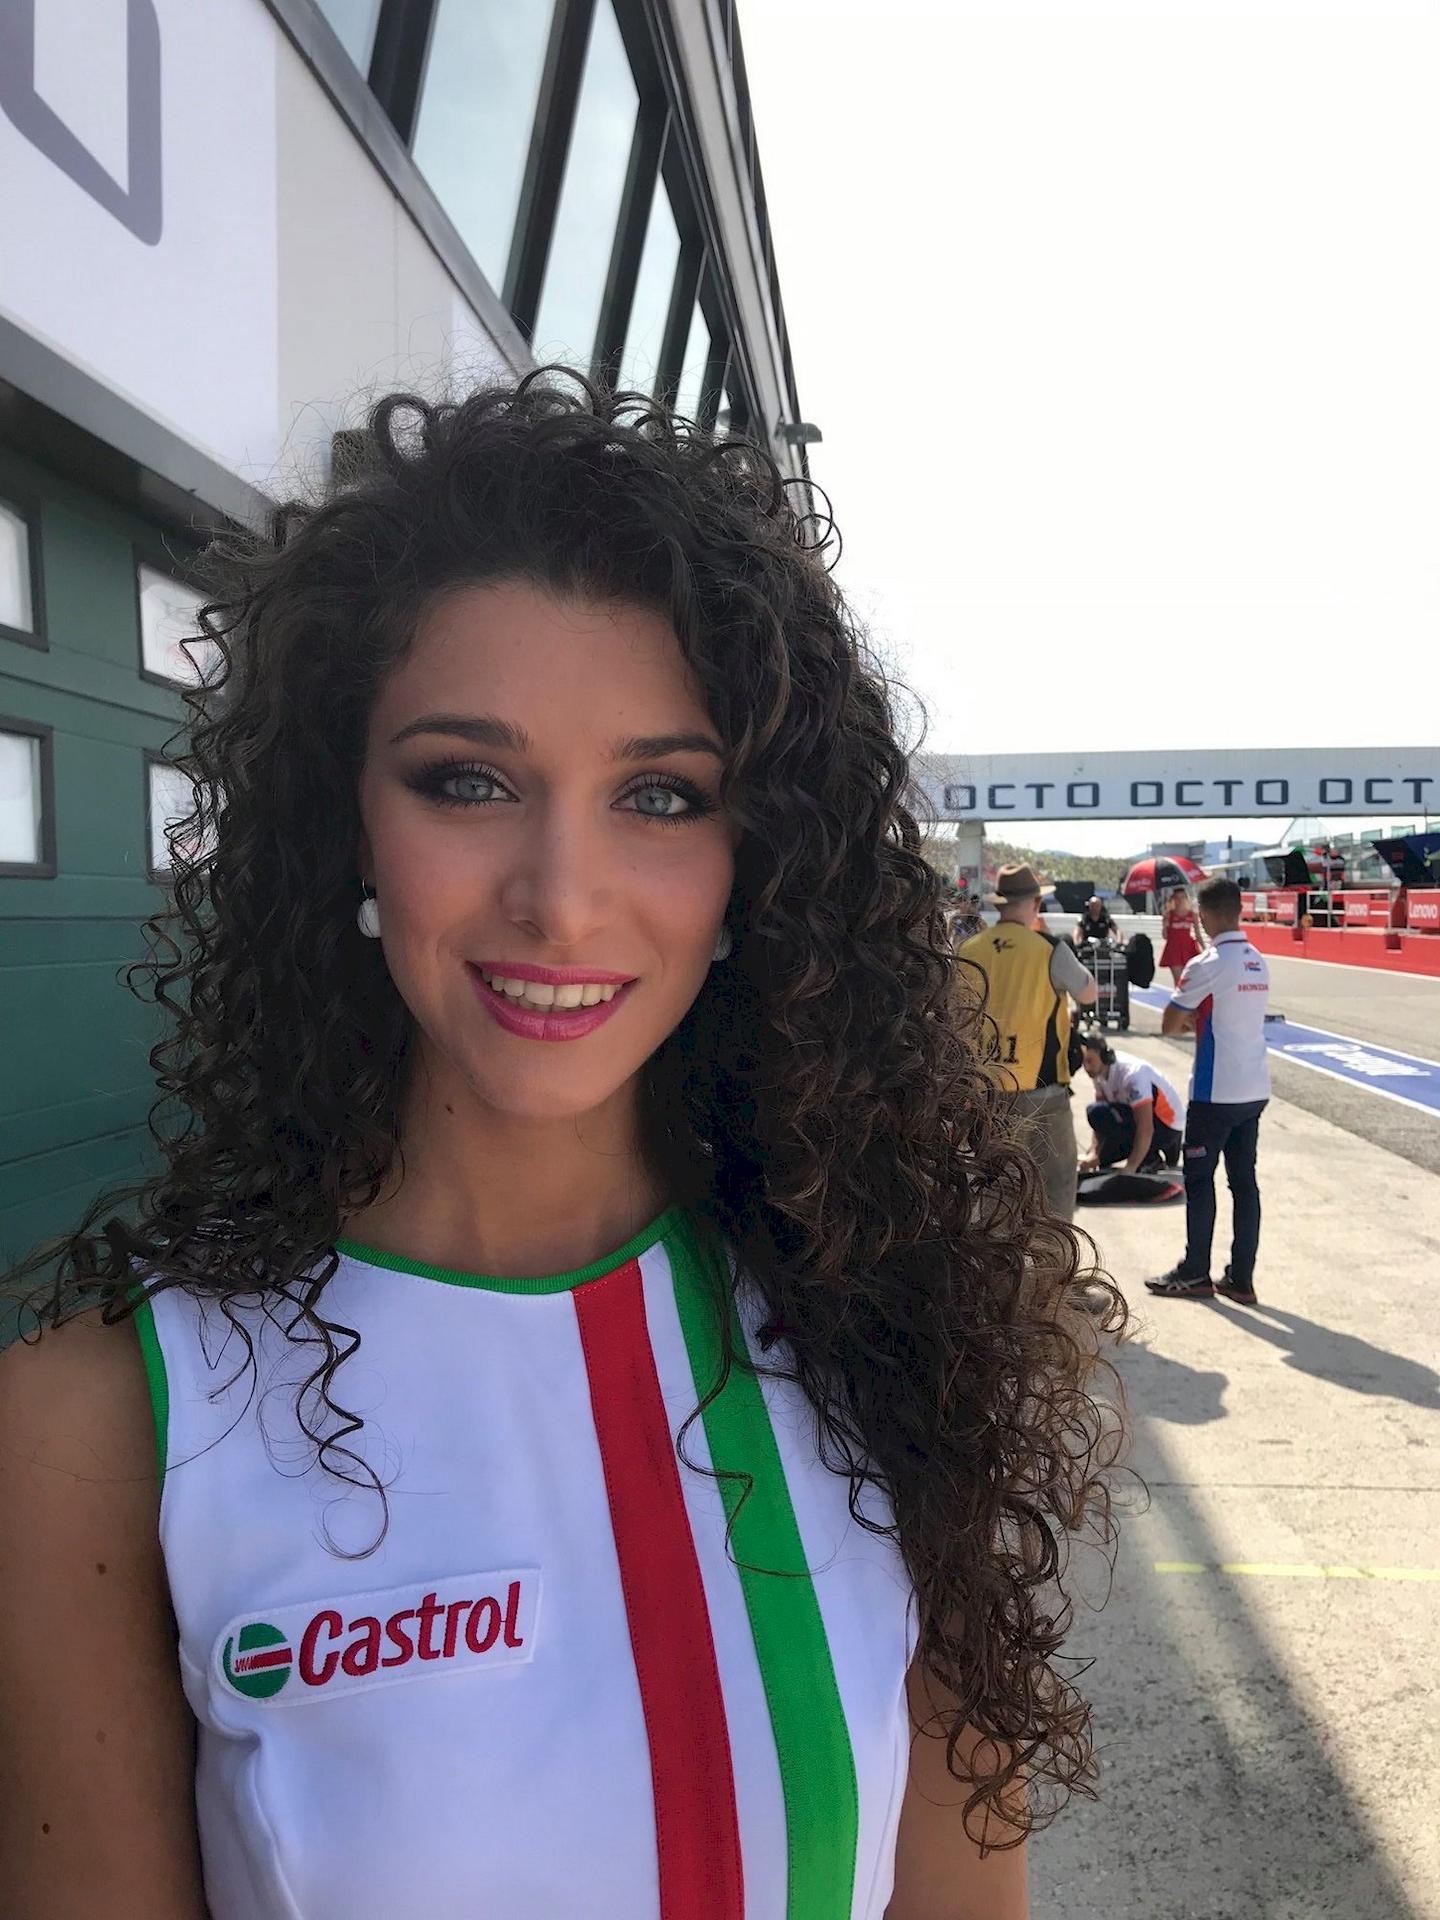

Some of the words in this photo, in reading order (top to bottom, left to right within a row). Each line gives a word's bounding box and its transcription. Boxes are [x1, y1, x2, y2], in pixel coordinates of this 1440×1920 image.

[943, 782, 1101, 810] OCTO
[1130, 779, 1289, 808] OCTO
[1408, 901, 1439, 920] Lenovo
[299, 1581, 524, 1687] Castrol
